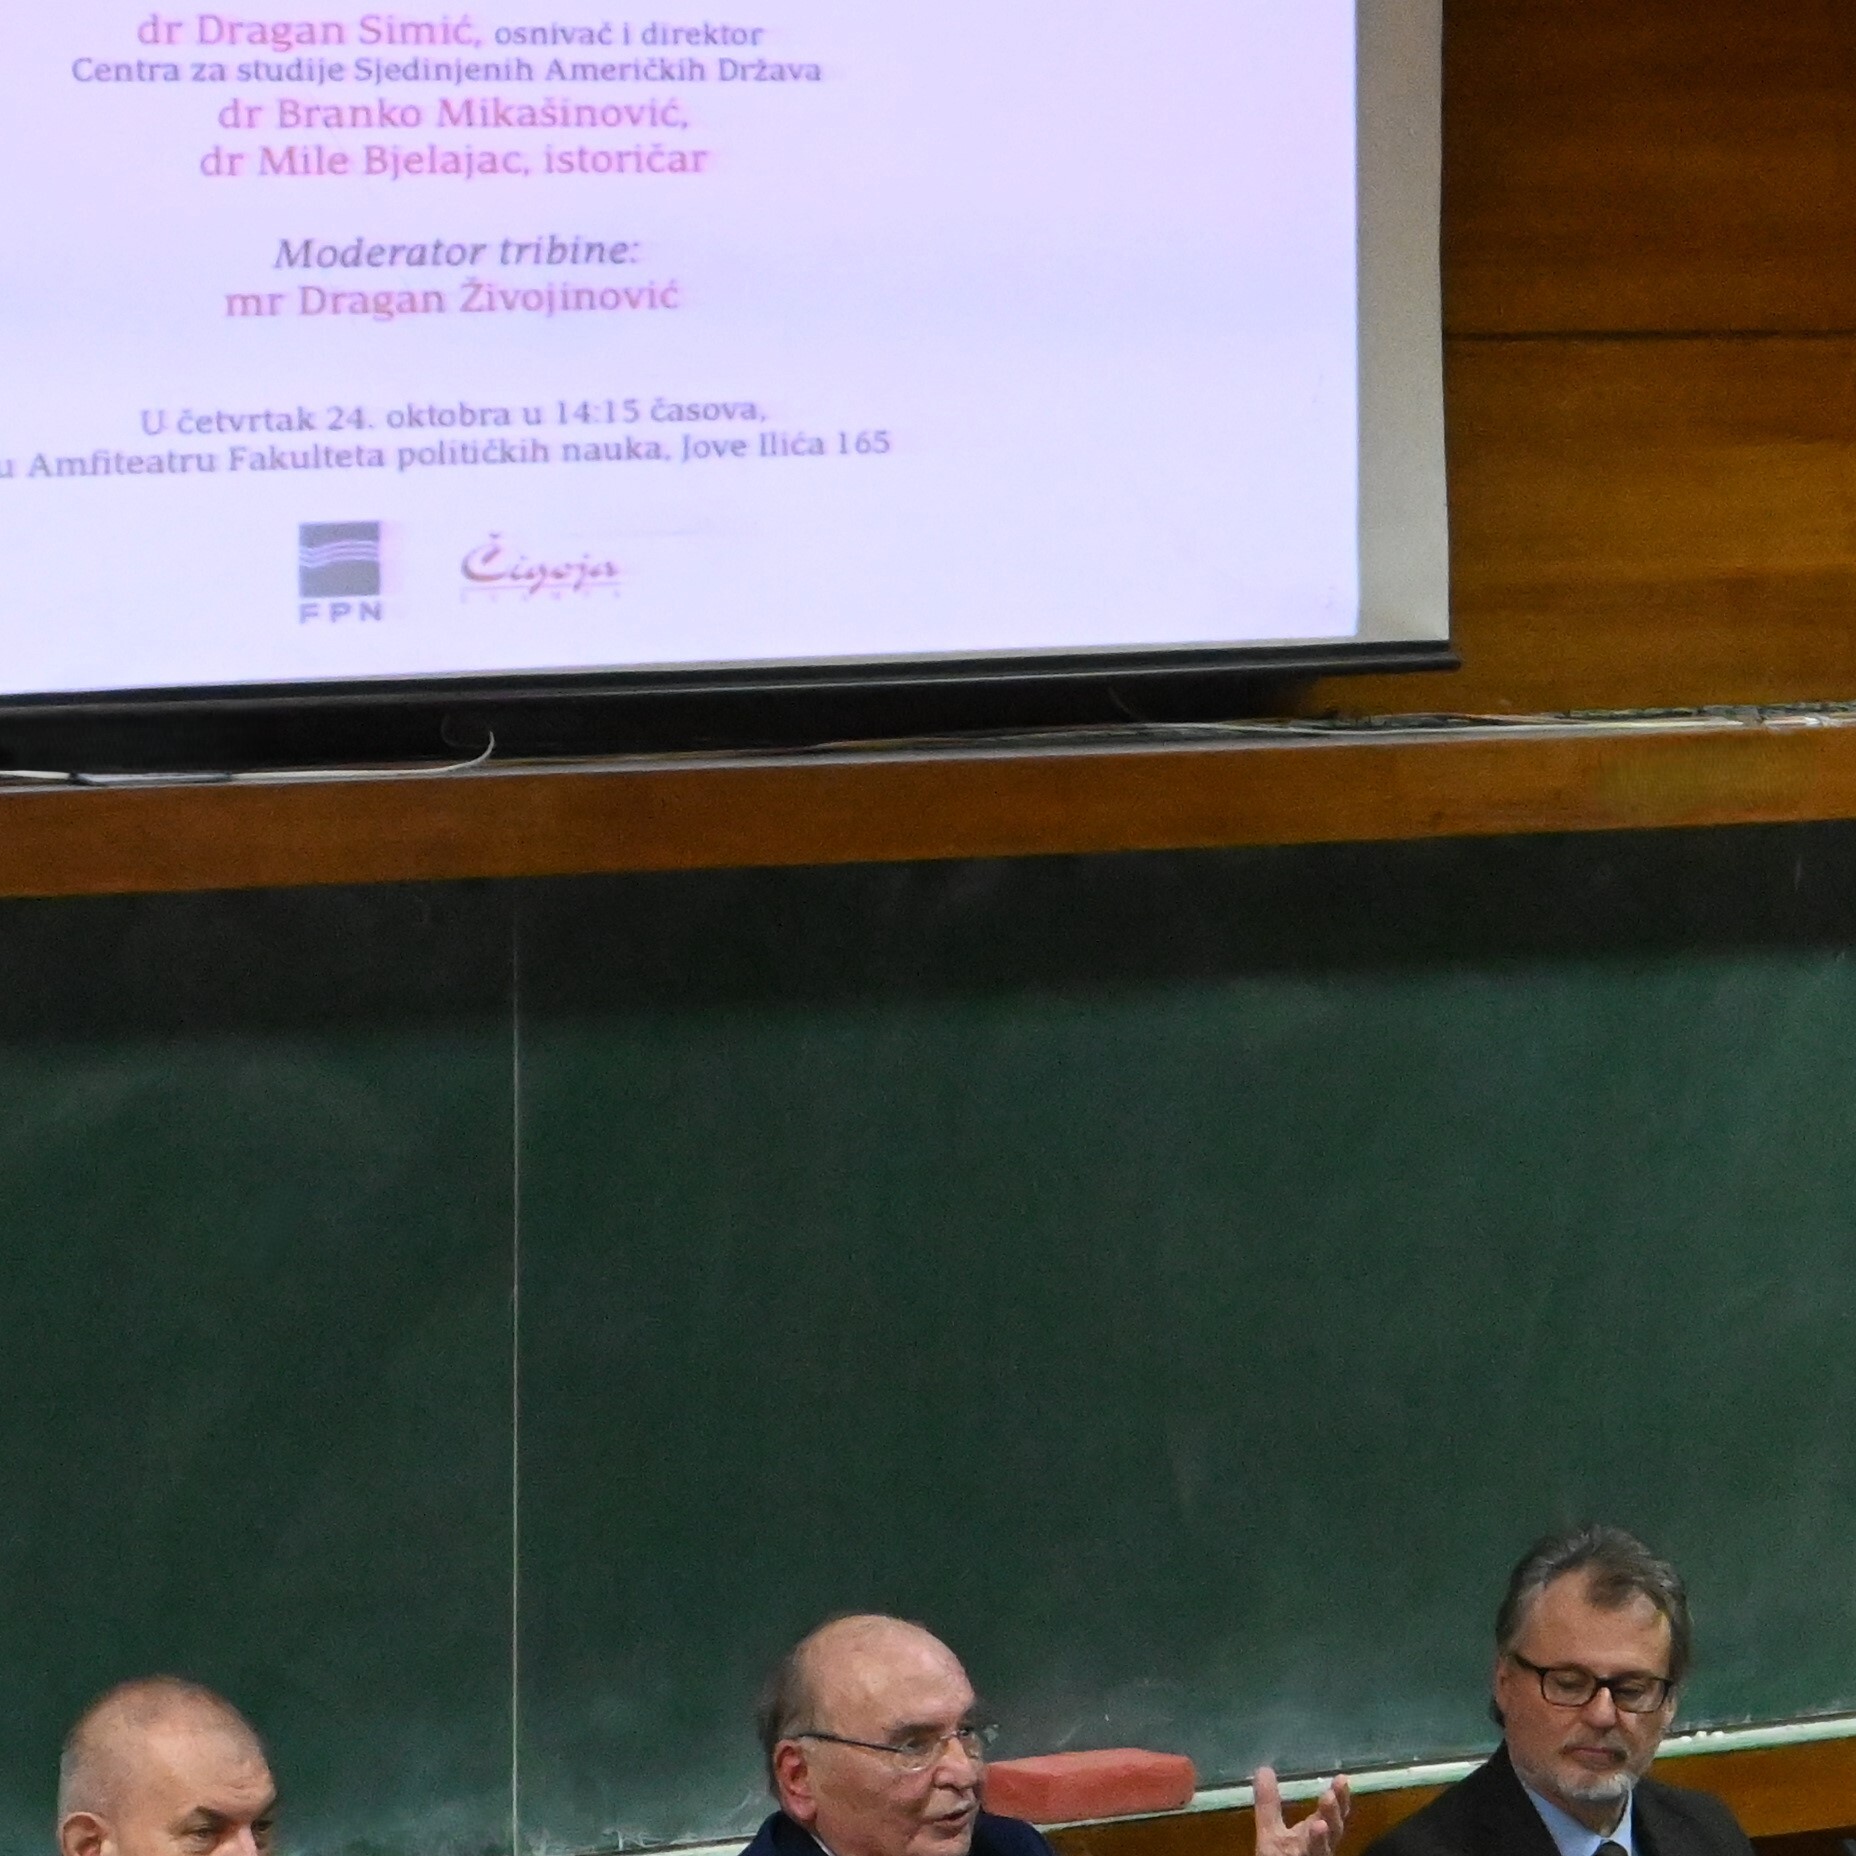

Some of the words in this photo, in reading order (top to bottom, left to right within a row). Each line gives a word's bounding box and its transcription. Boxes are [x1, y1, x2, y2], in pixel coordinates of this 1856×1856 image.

[137, 13, 183, 45] dr
[197, 13, 345, 52] Dragan
[358, 13, 482, 49] Simić,
[494, 21, 613, 46] osnivač
[623, 21, 631, 46] i
[640, 22, 764, 46] direktor
[71, 57, 181, 83] Centra
[190, 62, 226, 82] za
[237, 57, 344, 85] studije
[355, 57, 534, 85] Sjedinjenih
[546, 56, 706, 82] Američkih
[718, 56, 822, 82] Država
[217, 98, 263, 128] dr
[277, 98, 423, 129] Branko
[436, 97, 688, 130] Mikašinović,
[200, 145, 244, 176] dr
[258, 145, 349, 176] Mile
[364, 144, 530, 181] Bjelajac,
[545, 143, 709, 174] istoričar
[273, 236, 486, 269] Moderator
[499, 235, 640, 265] tribine:
[224, 292, 285, 317] mr
[299, 285, 444, 322] Dragan
[460, 276, 680, 318] Živojinović
[141, 409, 166, 436] U
[177, 406, 315, 435] četvrtak
[326, 406, 374, 431] 24.
[386, 402, 511, 431] oktobra
[523, 407, 542, 426] u
[557, 398, 640, 426] 14:15
[650, 397, 767, 423] časova,
[28, 448, 215, 478] Amfiteatru
[228, 443, 384, 472] Fakulteta
[396, 437, 549, 472] političkih
[680, 433, 746, 463] Jove
[759, 431, 825, 458] Ilića
[838, 430, 891, 457] 165
[299, 602, 382, 624] FPN
